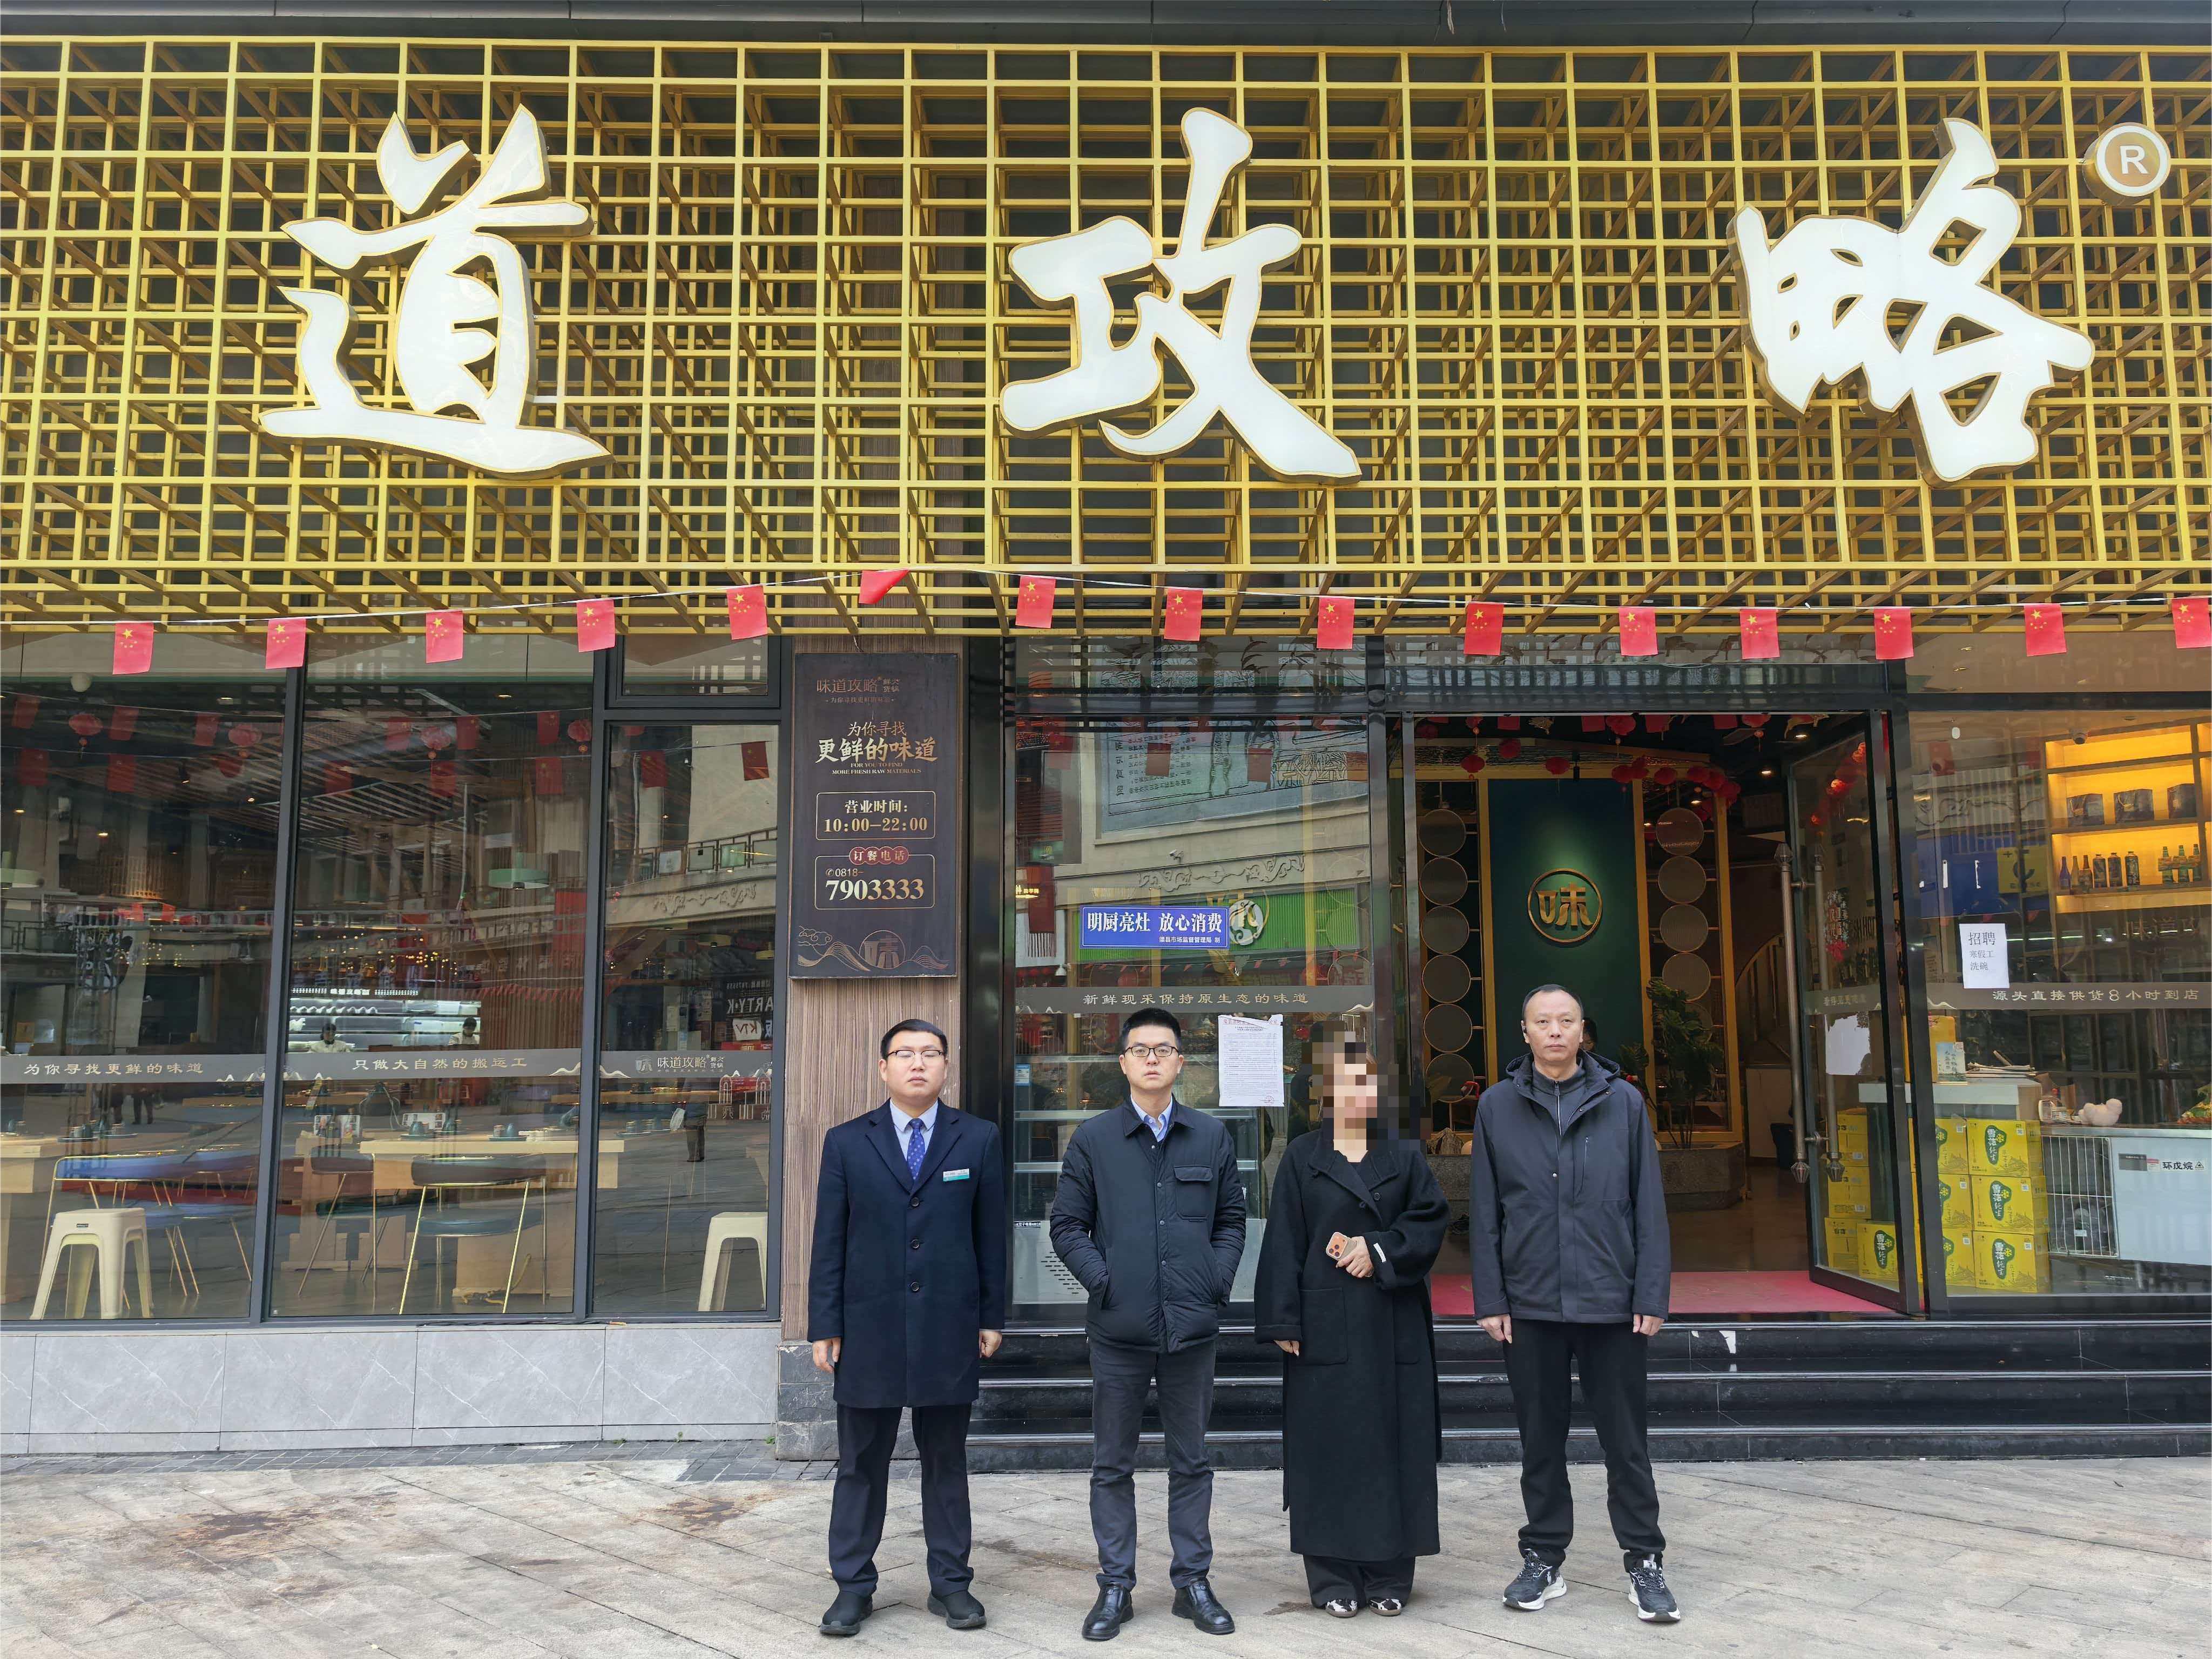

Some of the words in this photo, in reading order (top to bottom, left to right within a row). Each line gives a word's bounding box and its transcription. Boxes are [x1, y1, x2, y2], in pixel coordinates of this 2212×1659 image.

[258, 103, 2095, 482] 道攻略
[816, 678, 878, 693] 味道攻略
[847, 721, 907, 737] 为你寻找
[815, 736, 938, 763] 更鲜的味道
[845, 799, 908, 813] 营业时间：
[854, 850, 905, 861] 订餐电话
[825, 879, 925, 901] 7903333
[1087, 912, 1151, 932] 明厨亮灶
[1158, 912, 1223, 933] 放心消费
[1968, 932, 1997, 946] 招聘
[1970, 950, 1995, 958] 寒假工
[1970, 962, 1988, 972] 洗碗
[1082, 993, 1309, 1005] 新鲜现采保持原生态的味道
[1992, 989, 2200, 1001] 源头直接供货8小时到店
[24, 1063, 204, 1075] 为你寻找更鲜的味道
[352, 1058, 528, 1070] 只做大自然的搬运工
[657, 1056, 706, 1069] 味道攻略
[2162, 1161, 2194, 1170] 环戊烷
